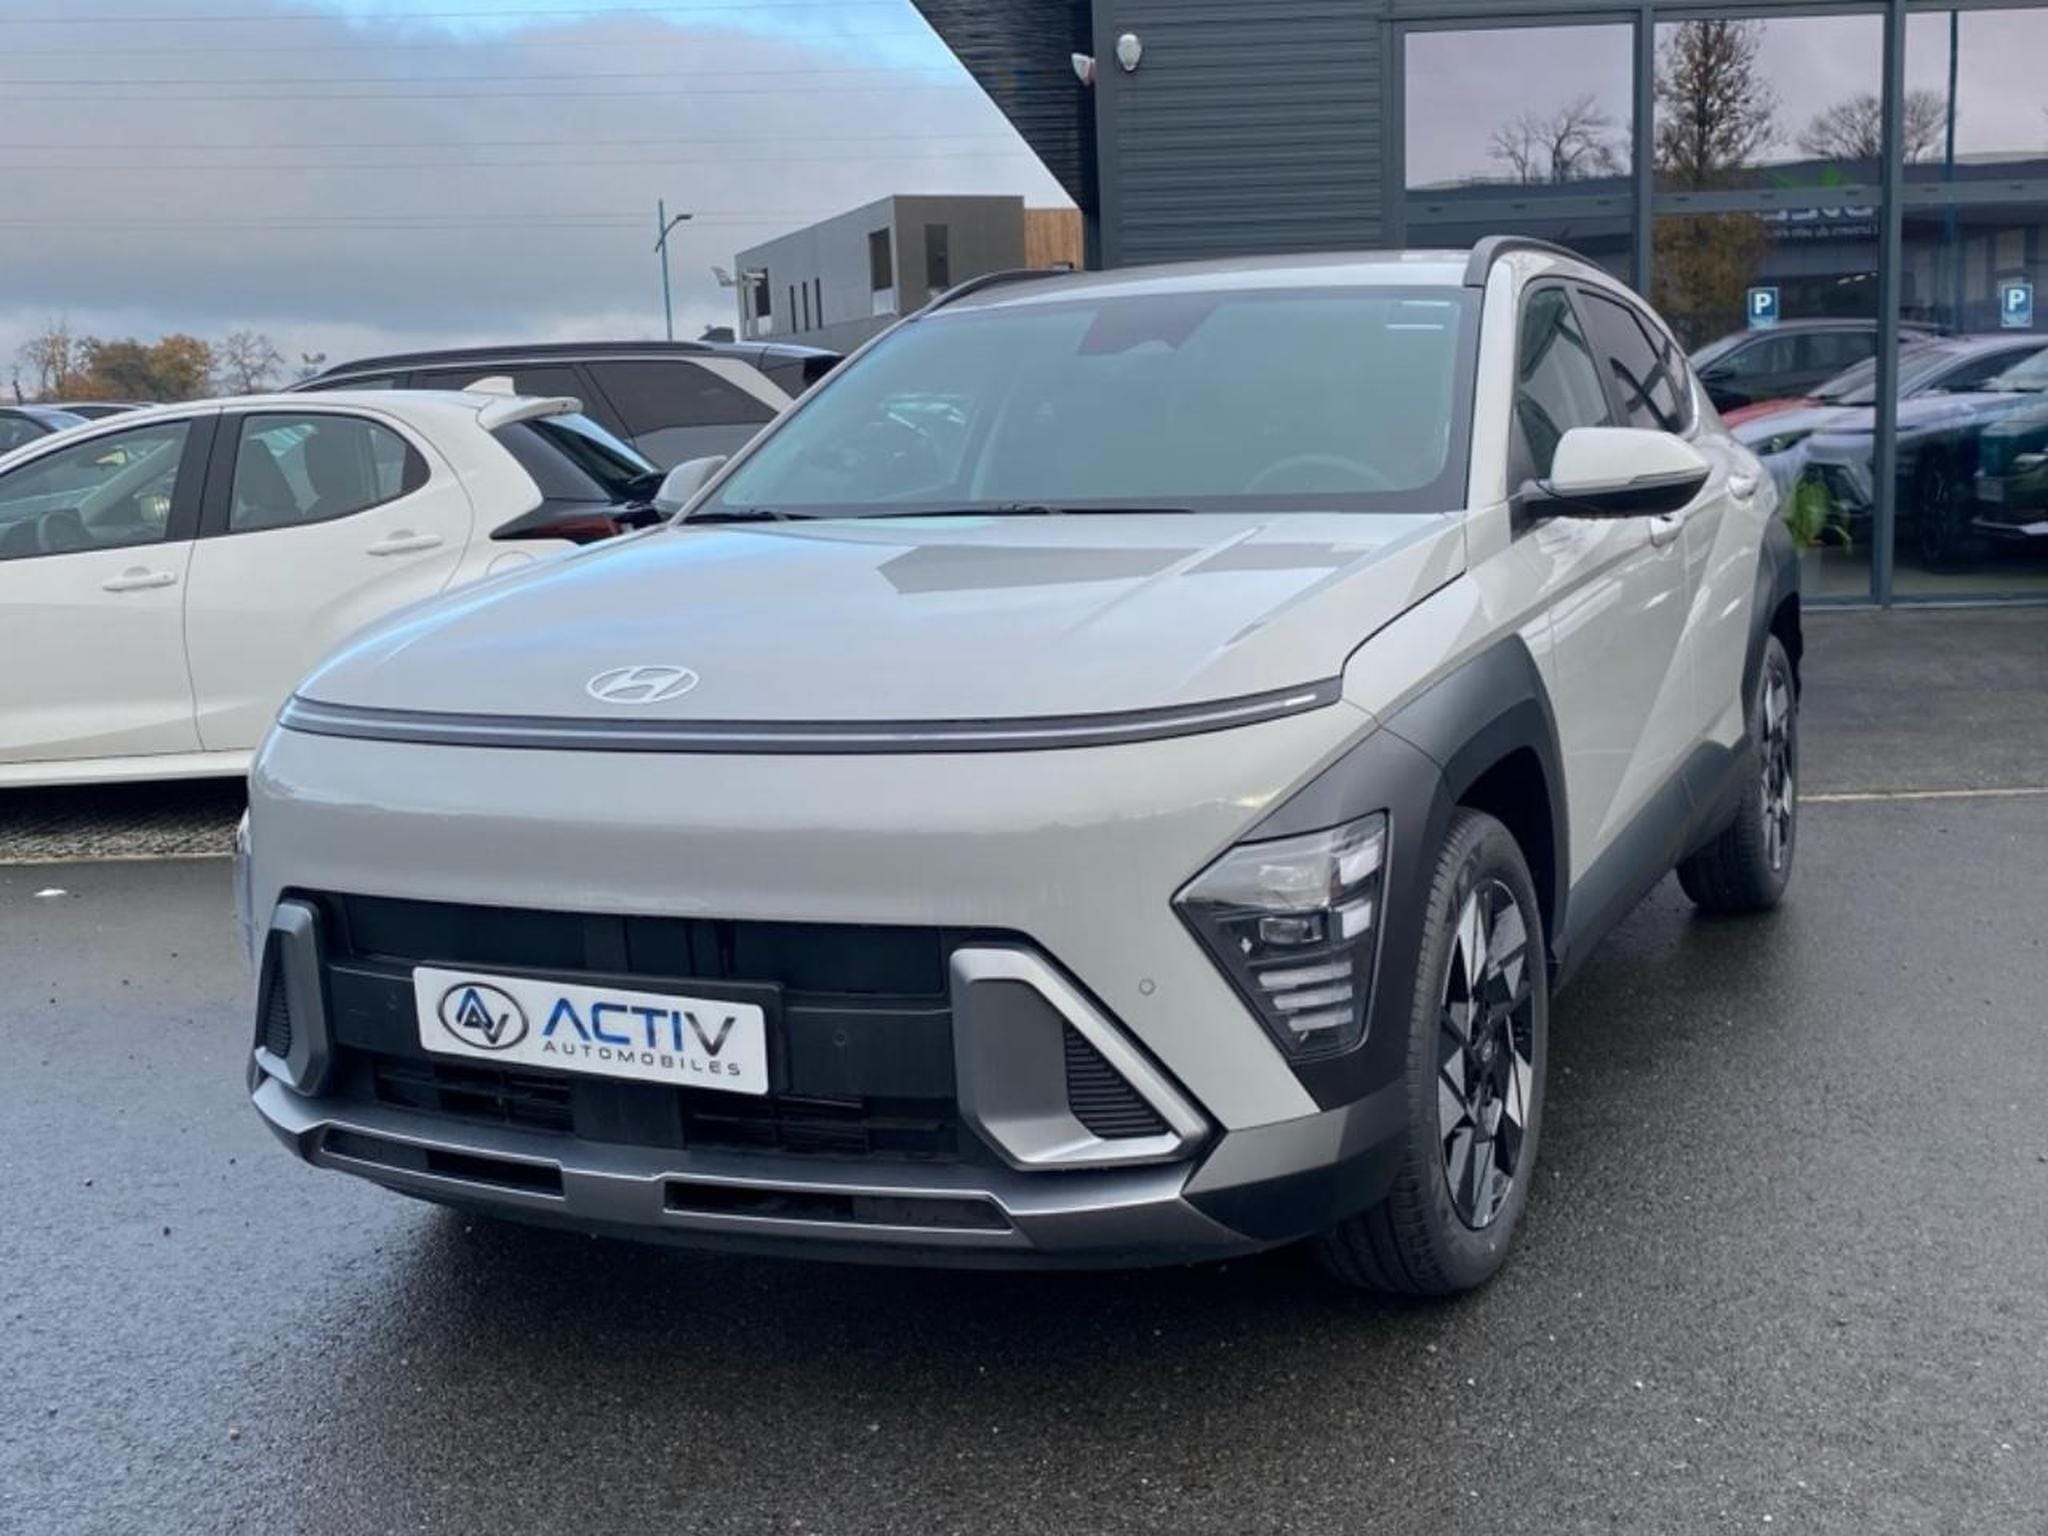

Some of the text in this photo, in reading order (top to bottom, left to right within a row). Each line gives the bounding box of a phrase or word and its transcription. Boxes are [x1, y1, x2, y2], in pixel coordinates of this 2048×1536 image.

[1755, 293, 1772, 314] P
[2009, 289, 2026, 311] P
[543, 998, 735, 1056] ACTIV
[543, 1040, 741, 1076] AUTOMOBILES
